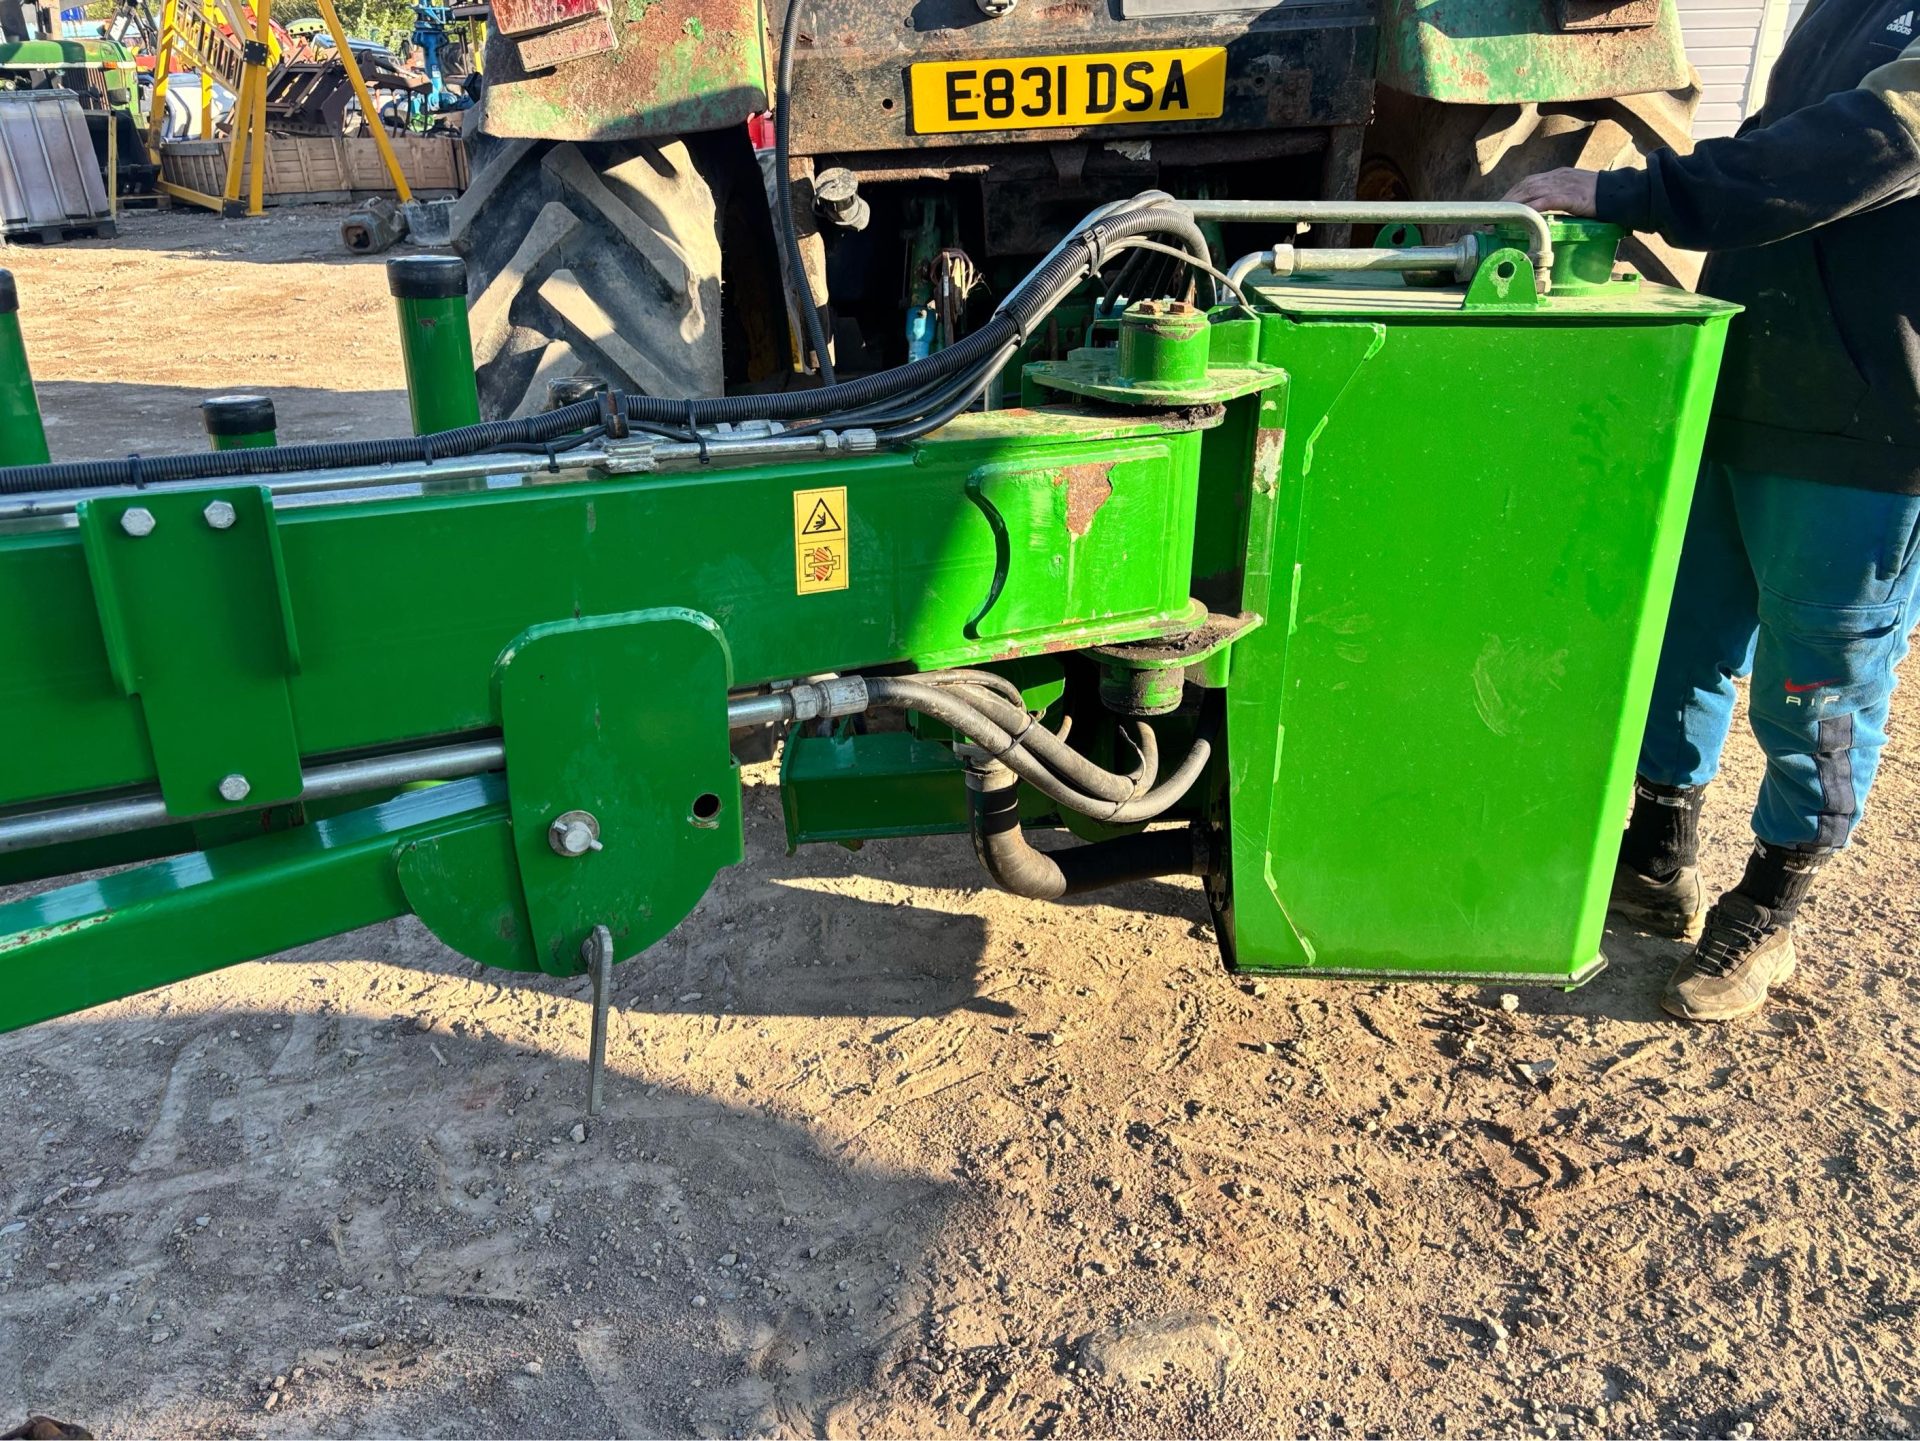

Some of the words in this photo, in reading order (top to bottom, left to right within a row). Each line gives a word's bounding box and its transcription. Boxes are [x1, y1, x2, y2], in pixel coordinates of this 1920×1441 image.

[1886, 23, 1913, 36] adidas
[945, 65, 1067, 122] E831
[1085, 59, 1190, 115] DSA
